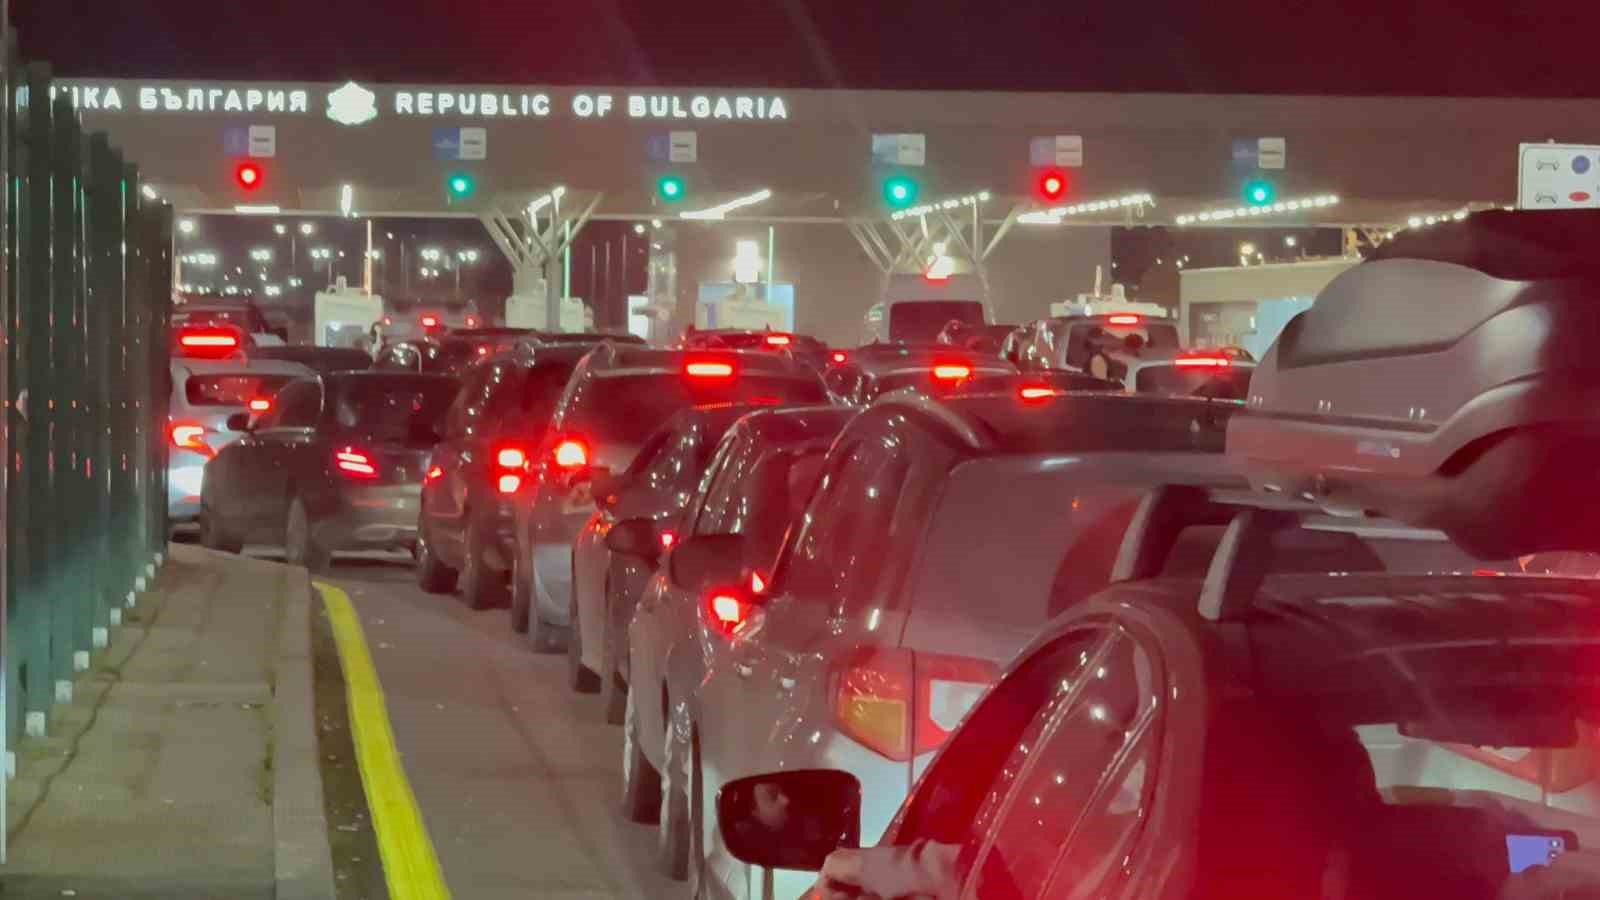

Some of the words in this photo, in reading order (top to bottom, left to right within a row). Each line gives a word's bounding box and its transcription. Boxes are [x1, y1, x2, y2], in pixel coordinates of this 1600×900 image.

[138, 86, 309, 113] БЪЛГАРИЯ
[394, 91, 550, 117] REPUBLIC
[572, 93, 614, 118] OF
[627, 94, 788, 120] BULGARIA
